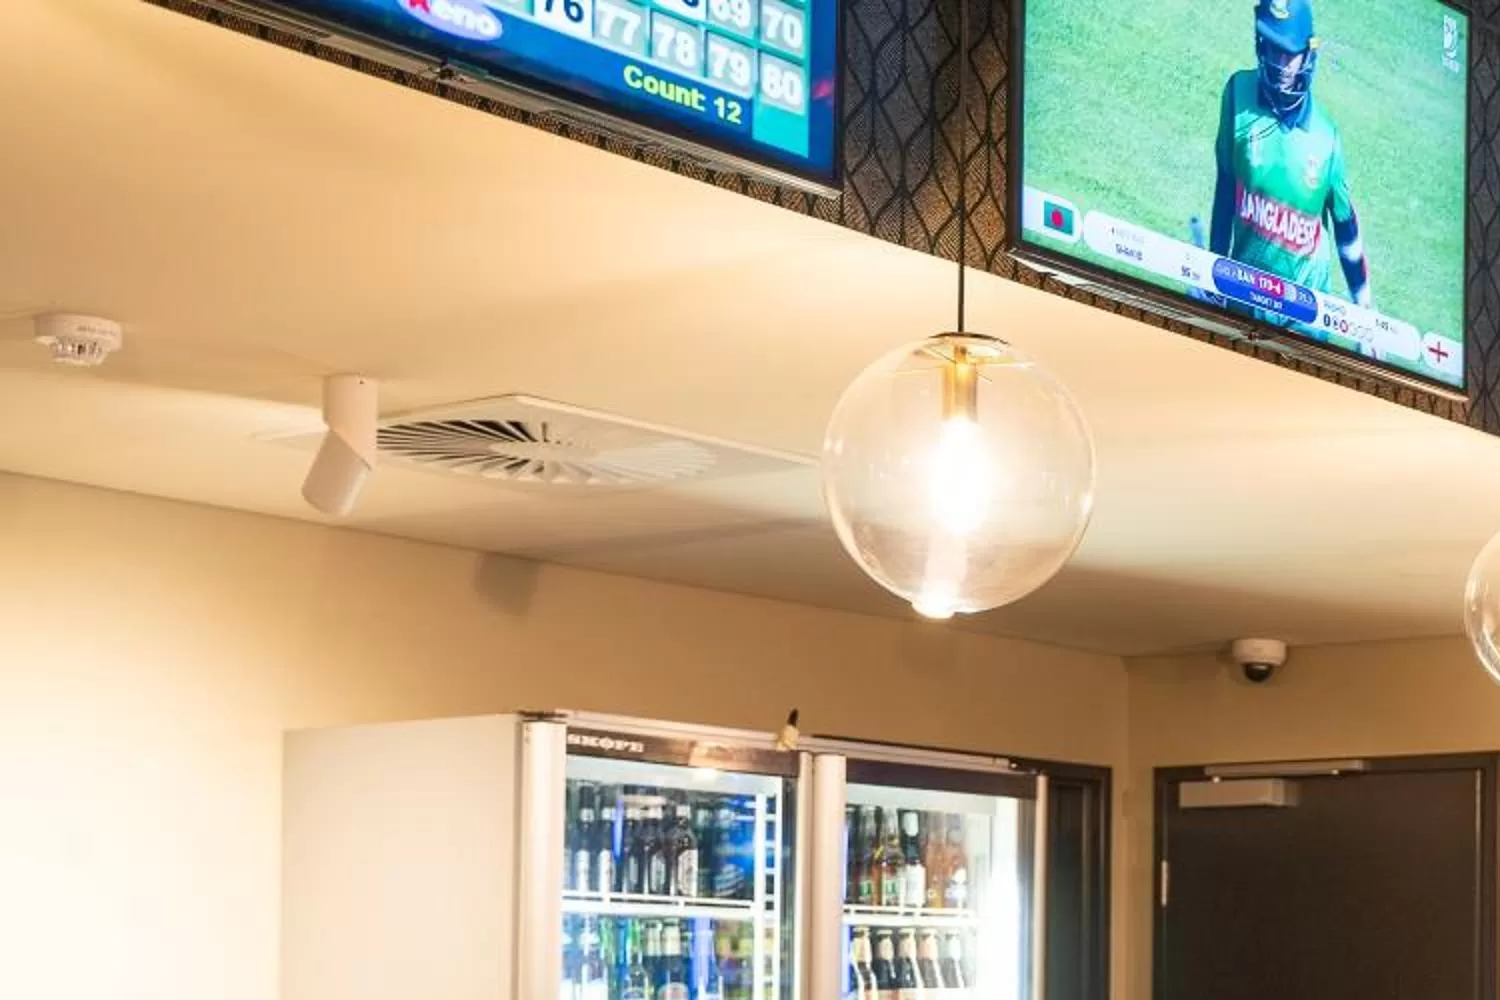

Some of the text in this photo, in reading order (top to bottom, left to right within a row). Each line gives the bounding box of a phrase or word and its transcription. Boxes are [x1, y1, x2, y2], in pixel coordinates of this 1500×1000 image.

[601, 5, 641, 45] 77
[653, 21, 696, 67] 78
[709, 40, 750, 86] 79
[763, 63, 803, 106] 80
[762, 4, 803, 49] 70
[623, 65, 742, 125] Count 12
